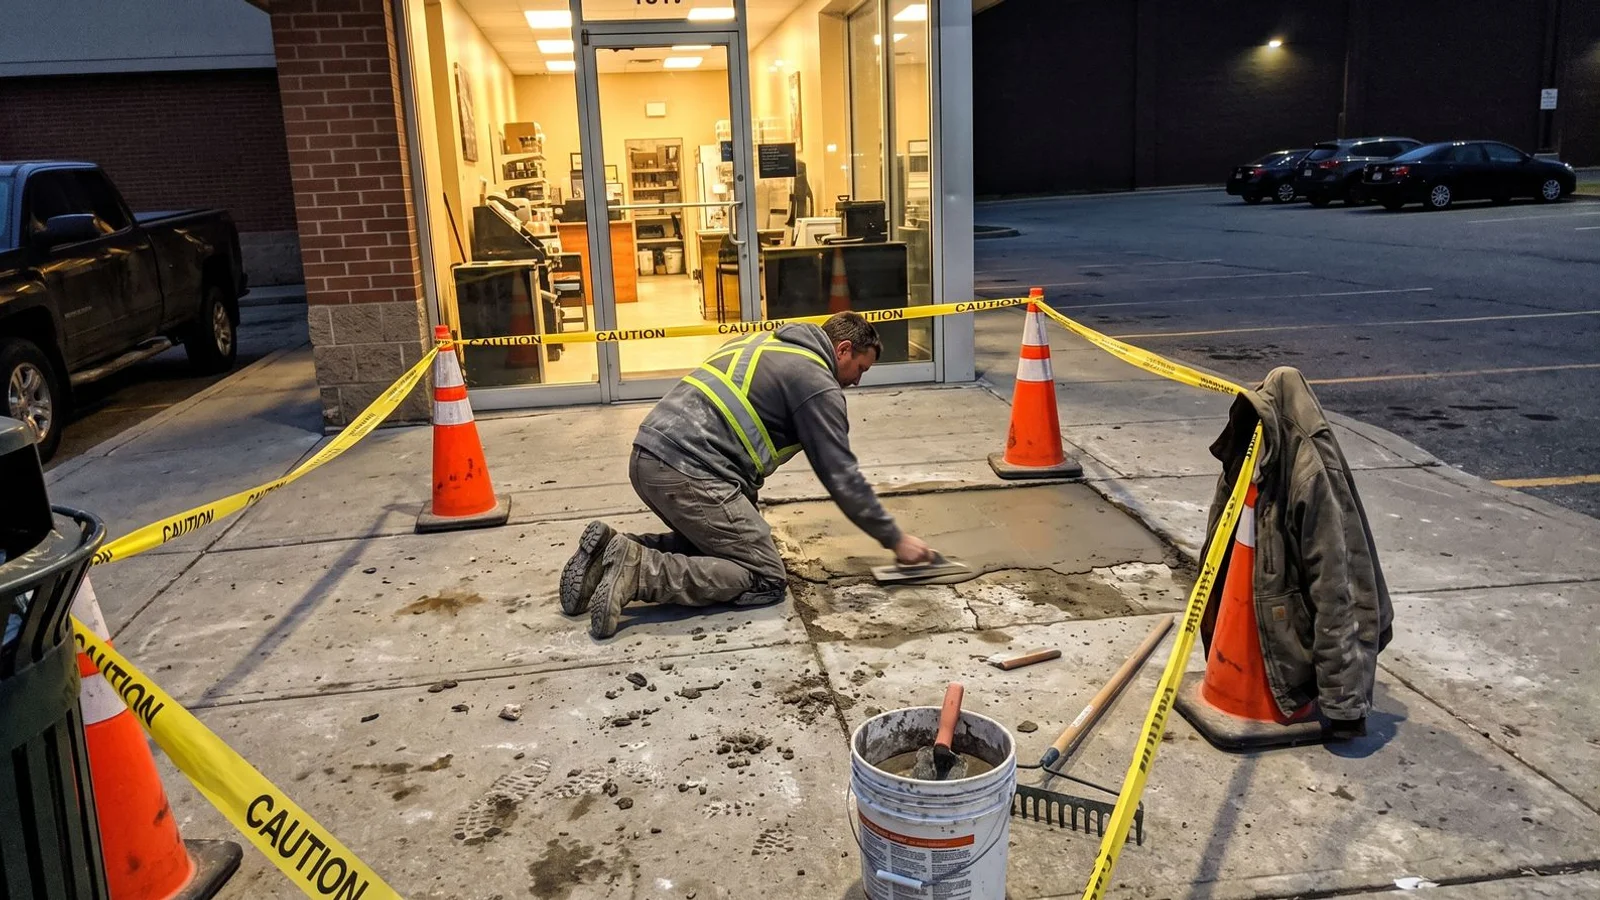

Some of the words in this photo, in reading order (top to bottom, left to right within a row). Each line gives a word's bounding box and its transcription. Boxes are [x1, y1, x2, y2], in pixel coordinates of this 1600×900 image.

[954, 298, 1022, 313] CAUTION
[864, 309, 903, 321] TION
[469, 335, 541, 346] CAUTION
[596, 328, 666, 342] CAUTION
[163, 509, 214, 544] CAUTION
[74, 633, 165, 728] CAUTION
[246, 794, 369, 900] CAUTION
